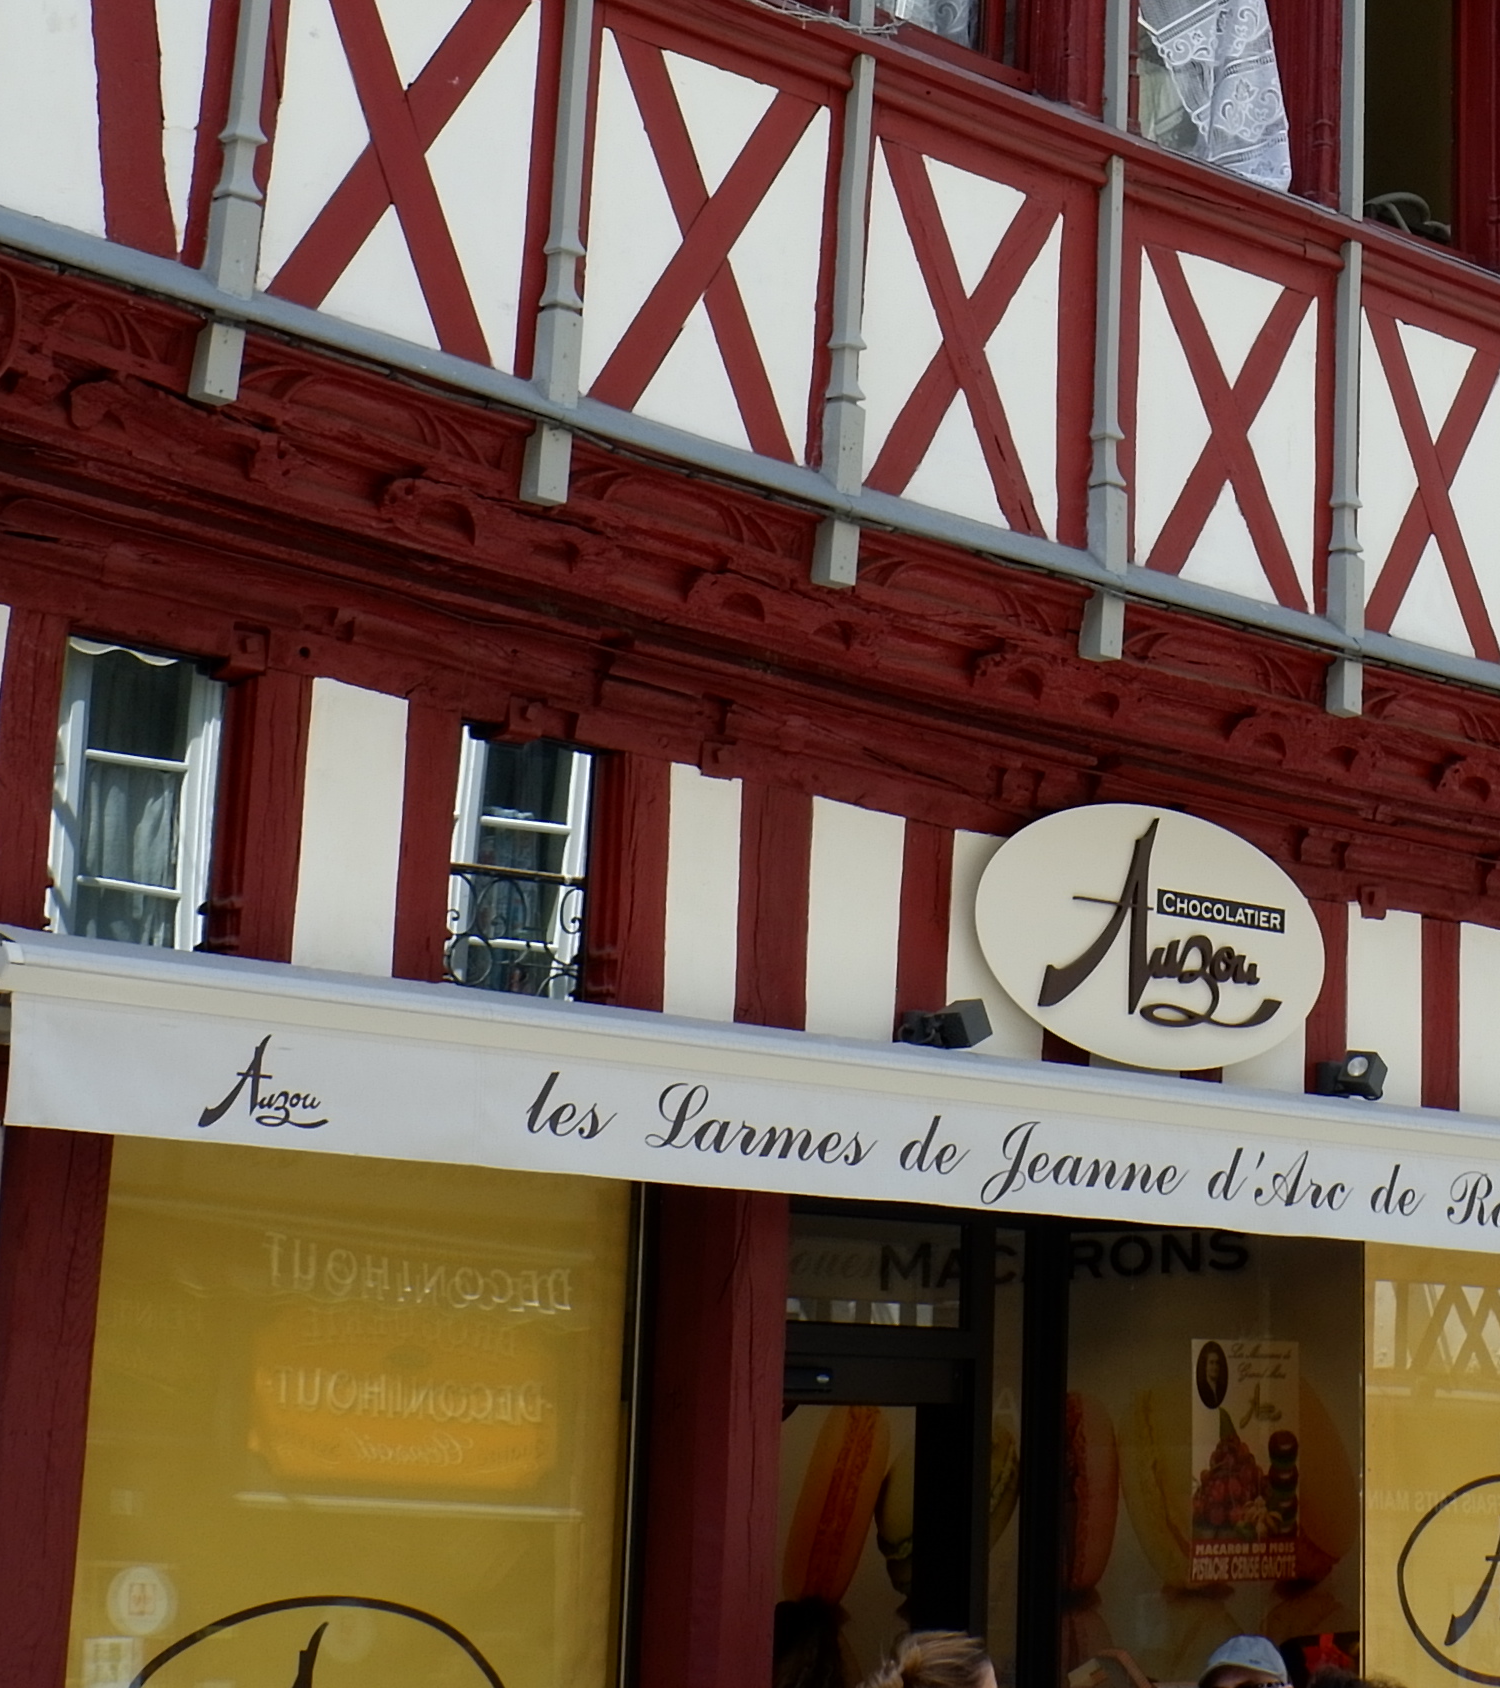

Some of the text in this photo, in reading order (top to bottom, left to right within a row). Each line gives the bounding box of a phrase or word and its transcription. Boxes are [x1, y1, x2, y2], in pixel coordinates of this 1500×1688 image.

[1037, 817, 1283, 1028] Auzou
[1162, 893, 1282, 931] CHOCOLATIER
[197, 1034, 330, 1129] Auzou
[527, 1071, 617, 1141] les
[644, 1081, 877, 1169] Larmes
[900, 1115, 969, 1176] de
[980, 1121, 1190, 1206] Jeanne
[1207, 1147, 1354, 1212] d'Arc
[1369, 1164, 1423, 1219] de
[1196, 1542, 1296, 1556] MACARON DU MOIS
